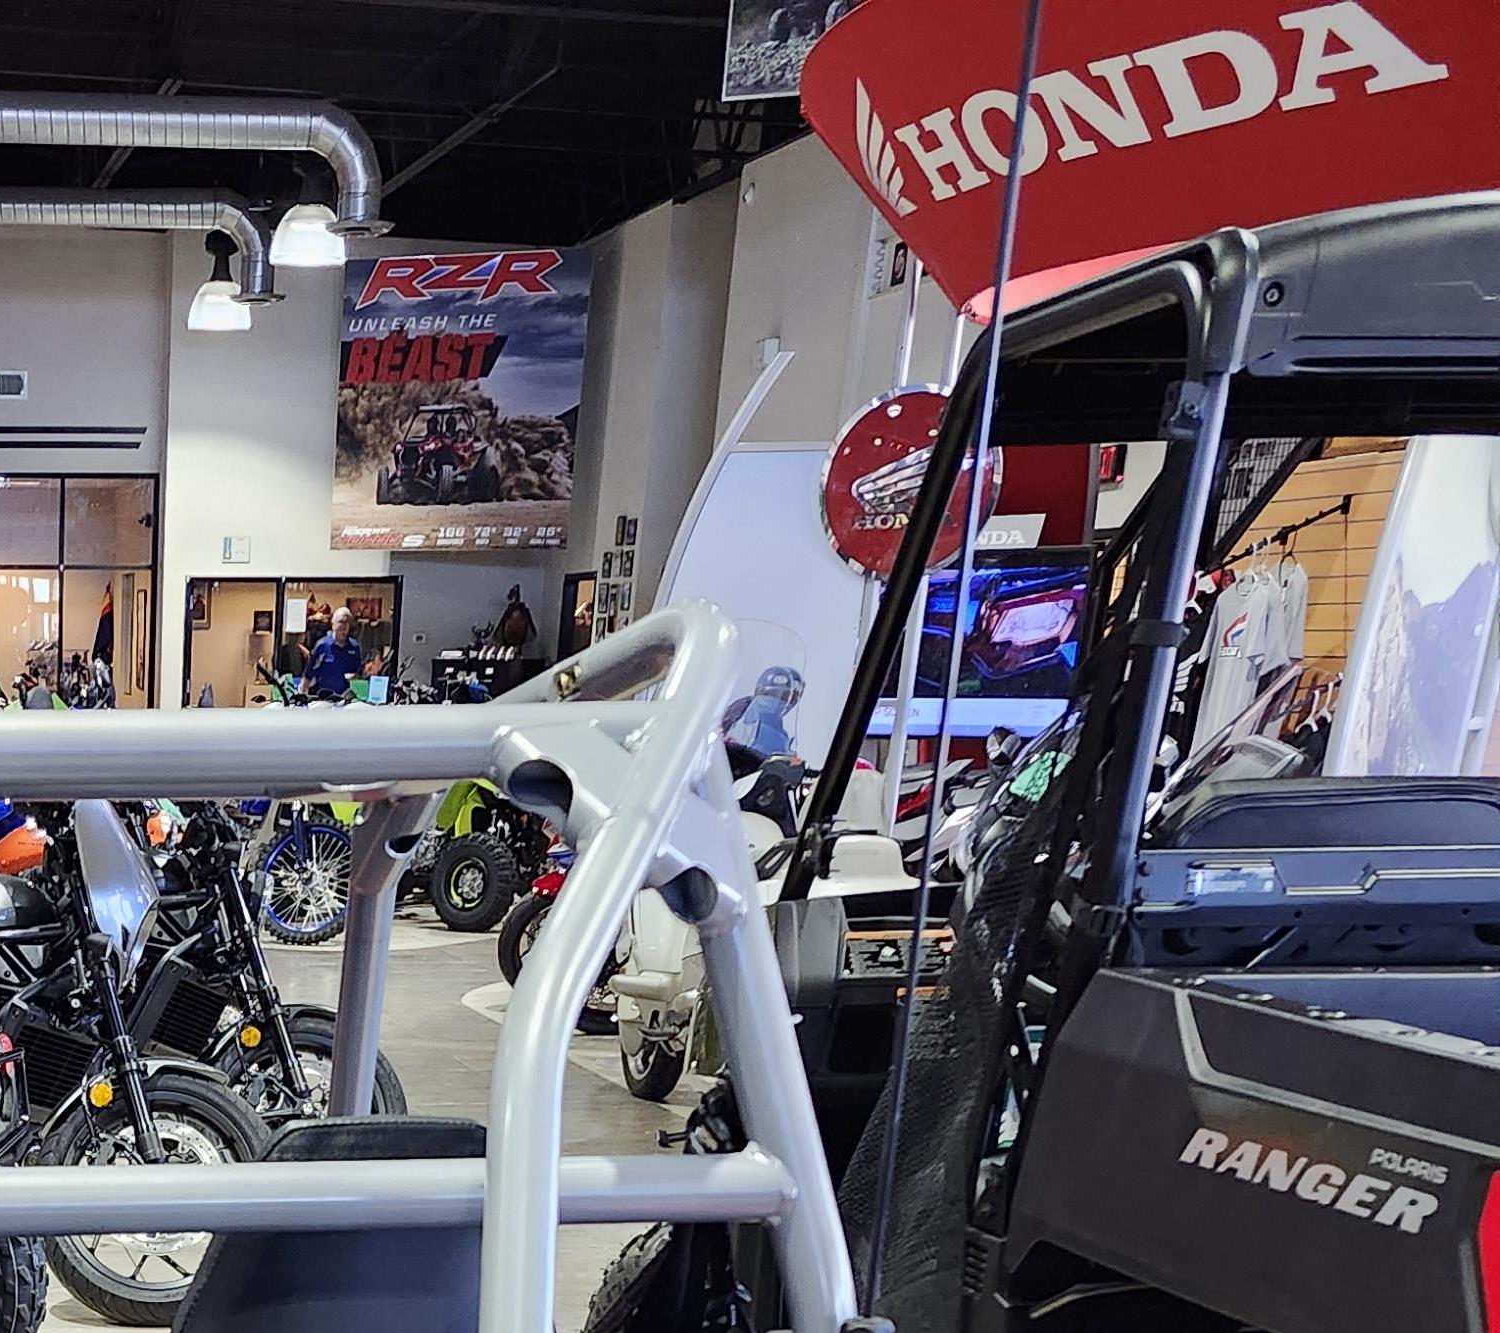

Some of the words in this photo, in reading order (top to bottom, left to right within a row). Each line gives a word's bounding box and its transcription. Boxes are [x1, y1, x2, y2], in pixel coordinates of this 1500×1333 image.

[894, 0, 1450, 202] HONDA
[355, 249, 564, 311] RZR
[349, 315, 448, 333] UNLEASH
[458, 313, 497, 329] THE
[346, 332, 497, 385] BEAST
[974, 530, 1027, 545] NDA
[1178, 1127, 1439, 1234] RANGER
[1368, 1148, 1449, 1185] POLARIS
